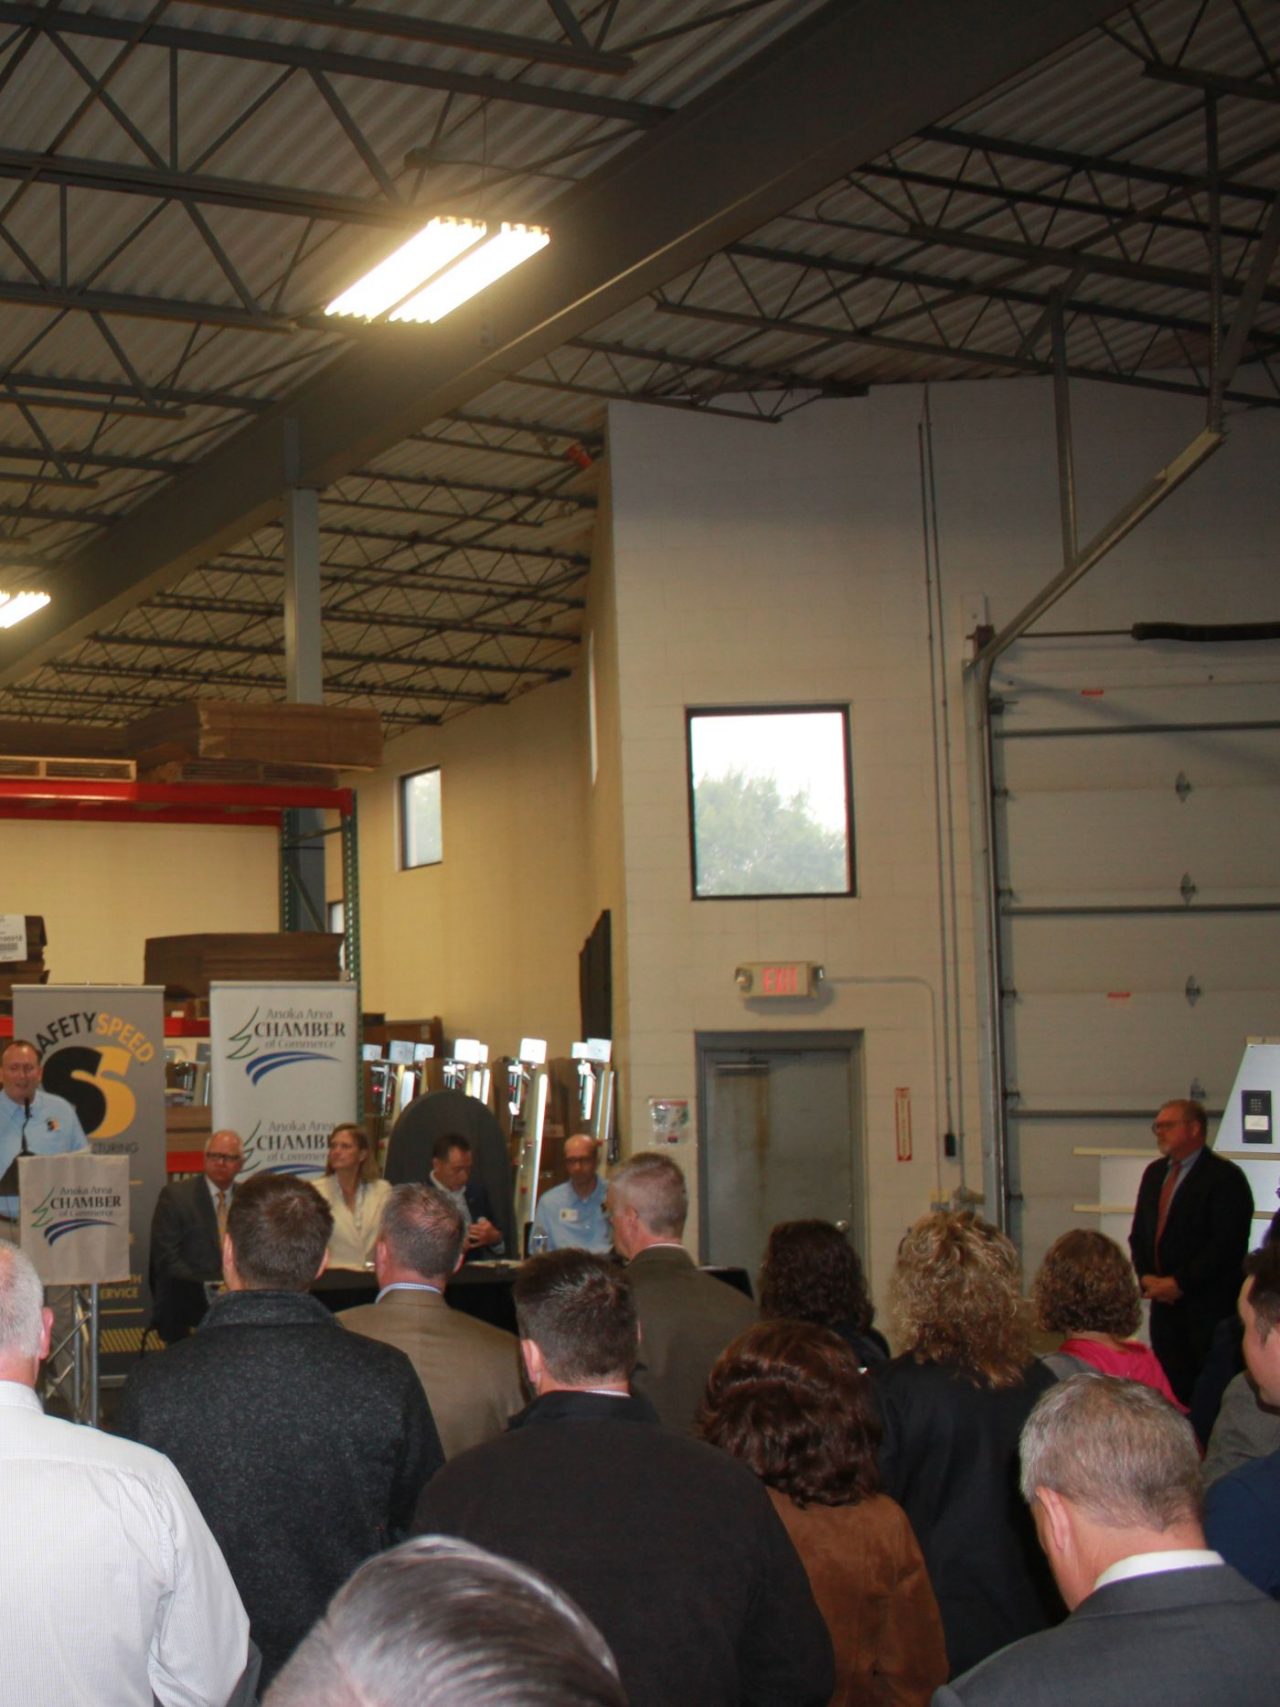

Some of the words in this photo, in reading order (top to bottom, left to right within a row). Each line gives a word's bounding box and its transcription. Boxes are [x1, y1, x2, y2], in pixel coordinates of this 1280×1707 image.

[762, 967, 797, 992] EXIT
[266, 1008, 304, 1019] Anoka
[308, 1008, 333, 1019] Area
[35, 1011, 97, 1054] AFETY
[254, 1022, 346, 1037] CHAMBER
[278, 1039, 335, 1049] Commerce
[268, 1120, 306, 1132] Anoka
[60, 1186, 89, 1195] Anoka
[91, 1186, 113, 1195] Area
[50, 1195, 122, 1209] CHAMBER
[98, 1287, 139, 1299] ERVICE
